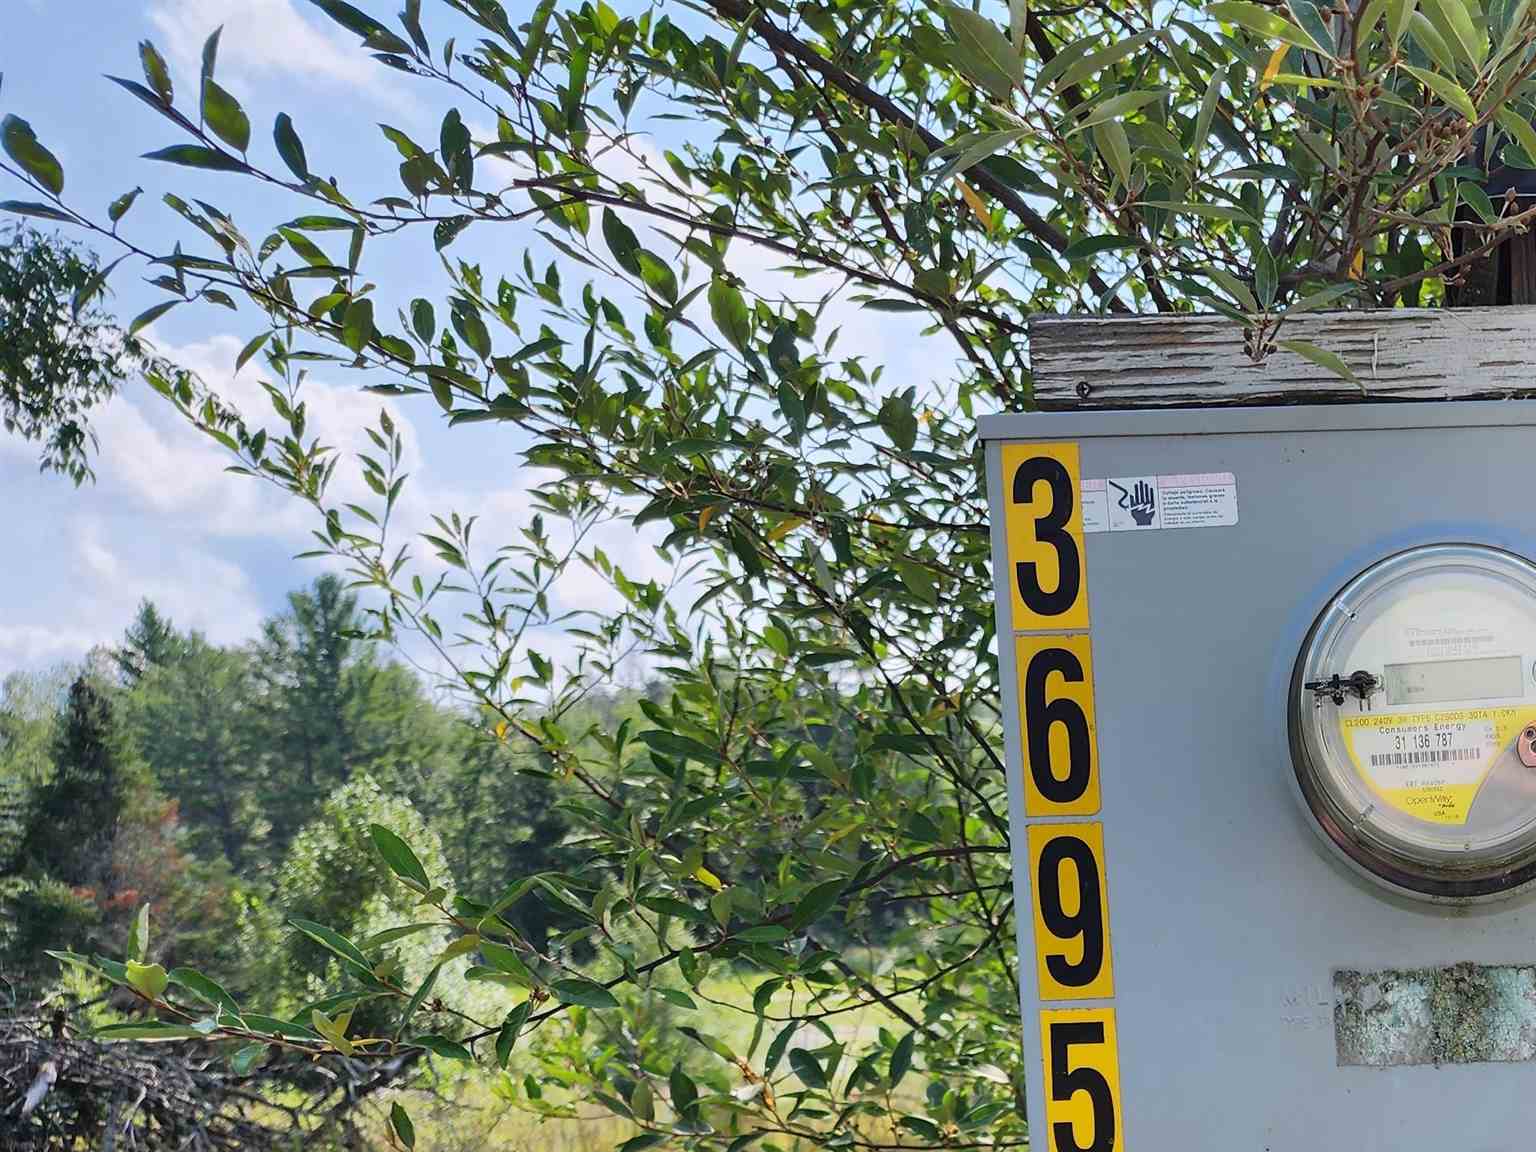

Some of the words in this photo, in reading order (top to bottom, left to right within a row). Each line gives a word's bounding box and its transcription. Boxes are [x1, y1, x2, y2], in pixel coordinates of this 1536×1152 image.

[1379, 725, 1429, 735] Consumers
[1434, 722, 1466, 732] Energy
[1395, 736, 1406, 750] 31
[1414, 734, 1431, 749] 136
[1436, 733, 1453, 747] 787
